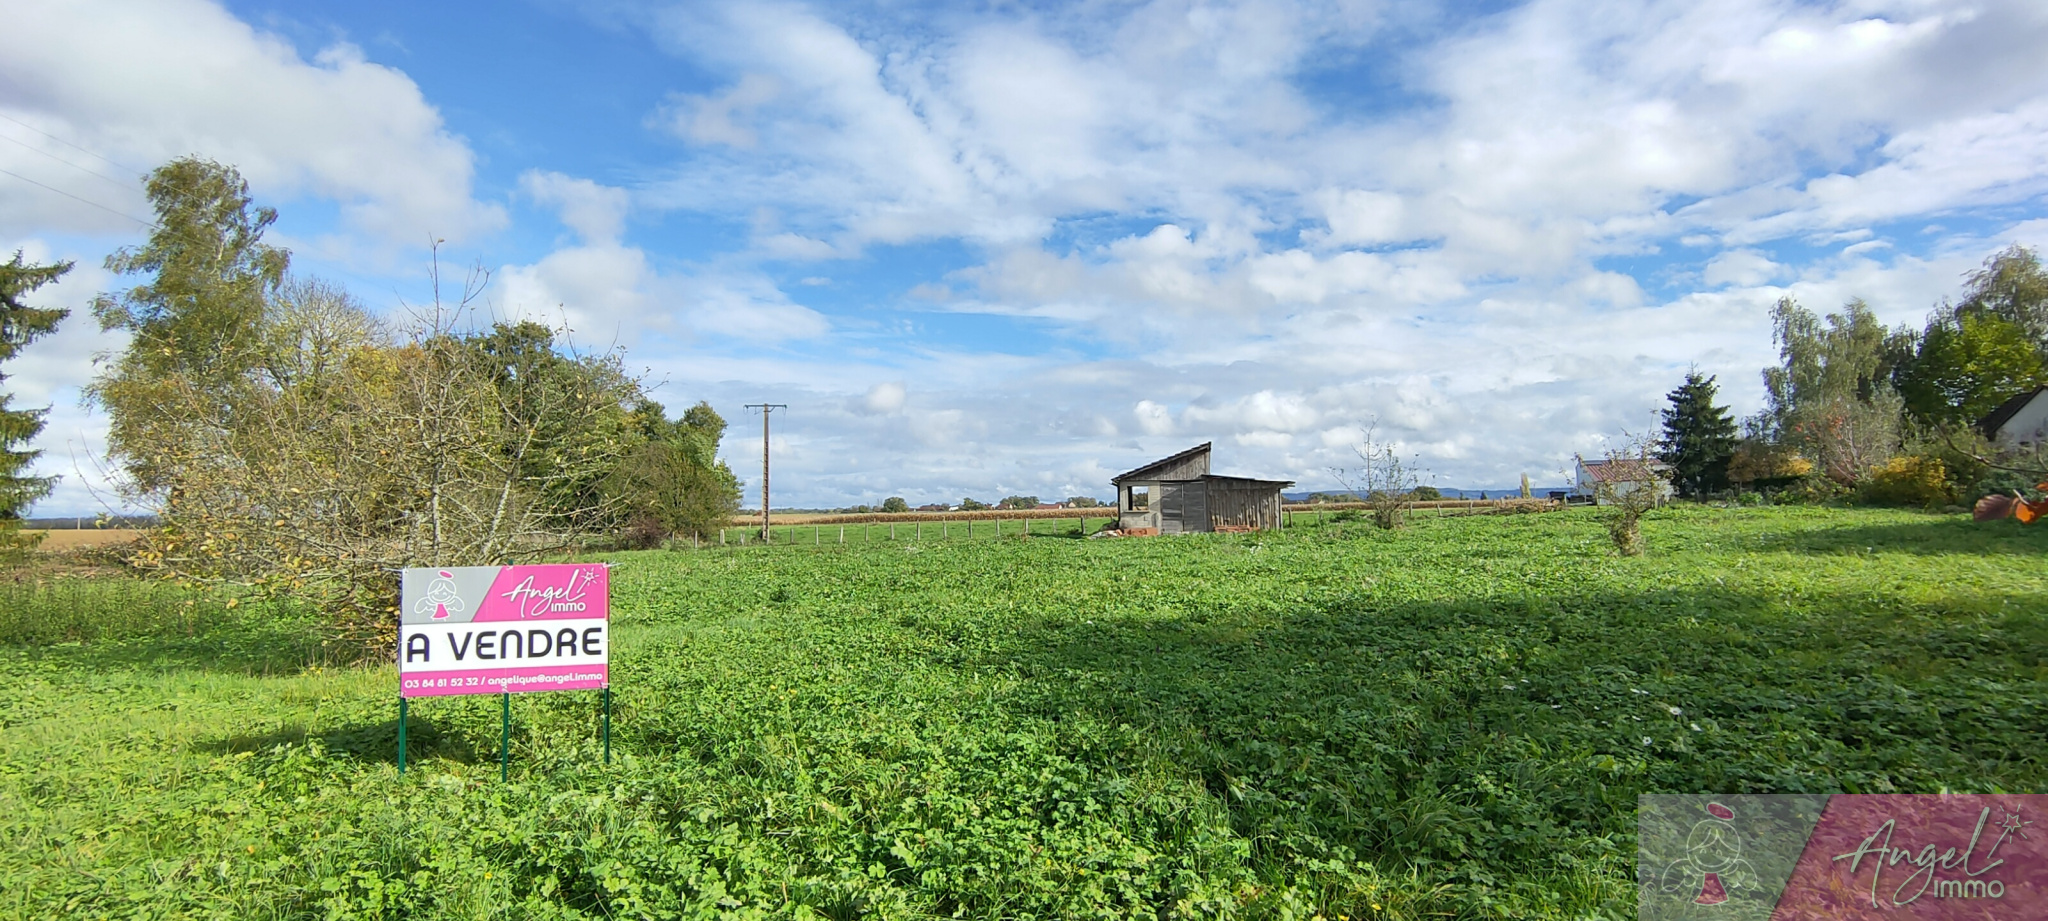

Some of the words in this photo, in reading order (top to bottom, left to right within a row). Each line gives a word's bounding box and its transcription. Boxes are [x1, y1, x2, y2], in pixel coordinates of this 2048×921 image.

[501, 568, 586, 618] Angel
[406, 632, 430, 663] A
[447, 627, 603, 661] VENDRE
[404, 679, 420, 689] 03
[422, 678, 435, 688] 84
[437, 678, 447, 688] 81
[450, 677, 463, 687] 52
[465, 677, 479, 687] 32
[480, 676, 486, 686] /
[488, 672, 603, 686] angelique@angel.immo
